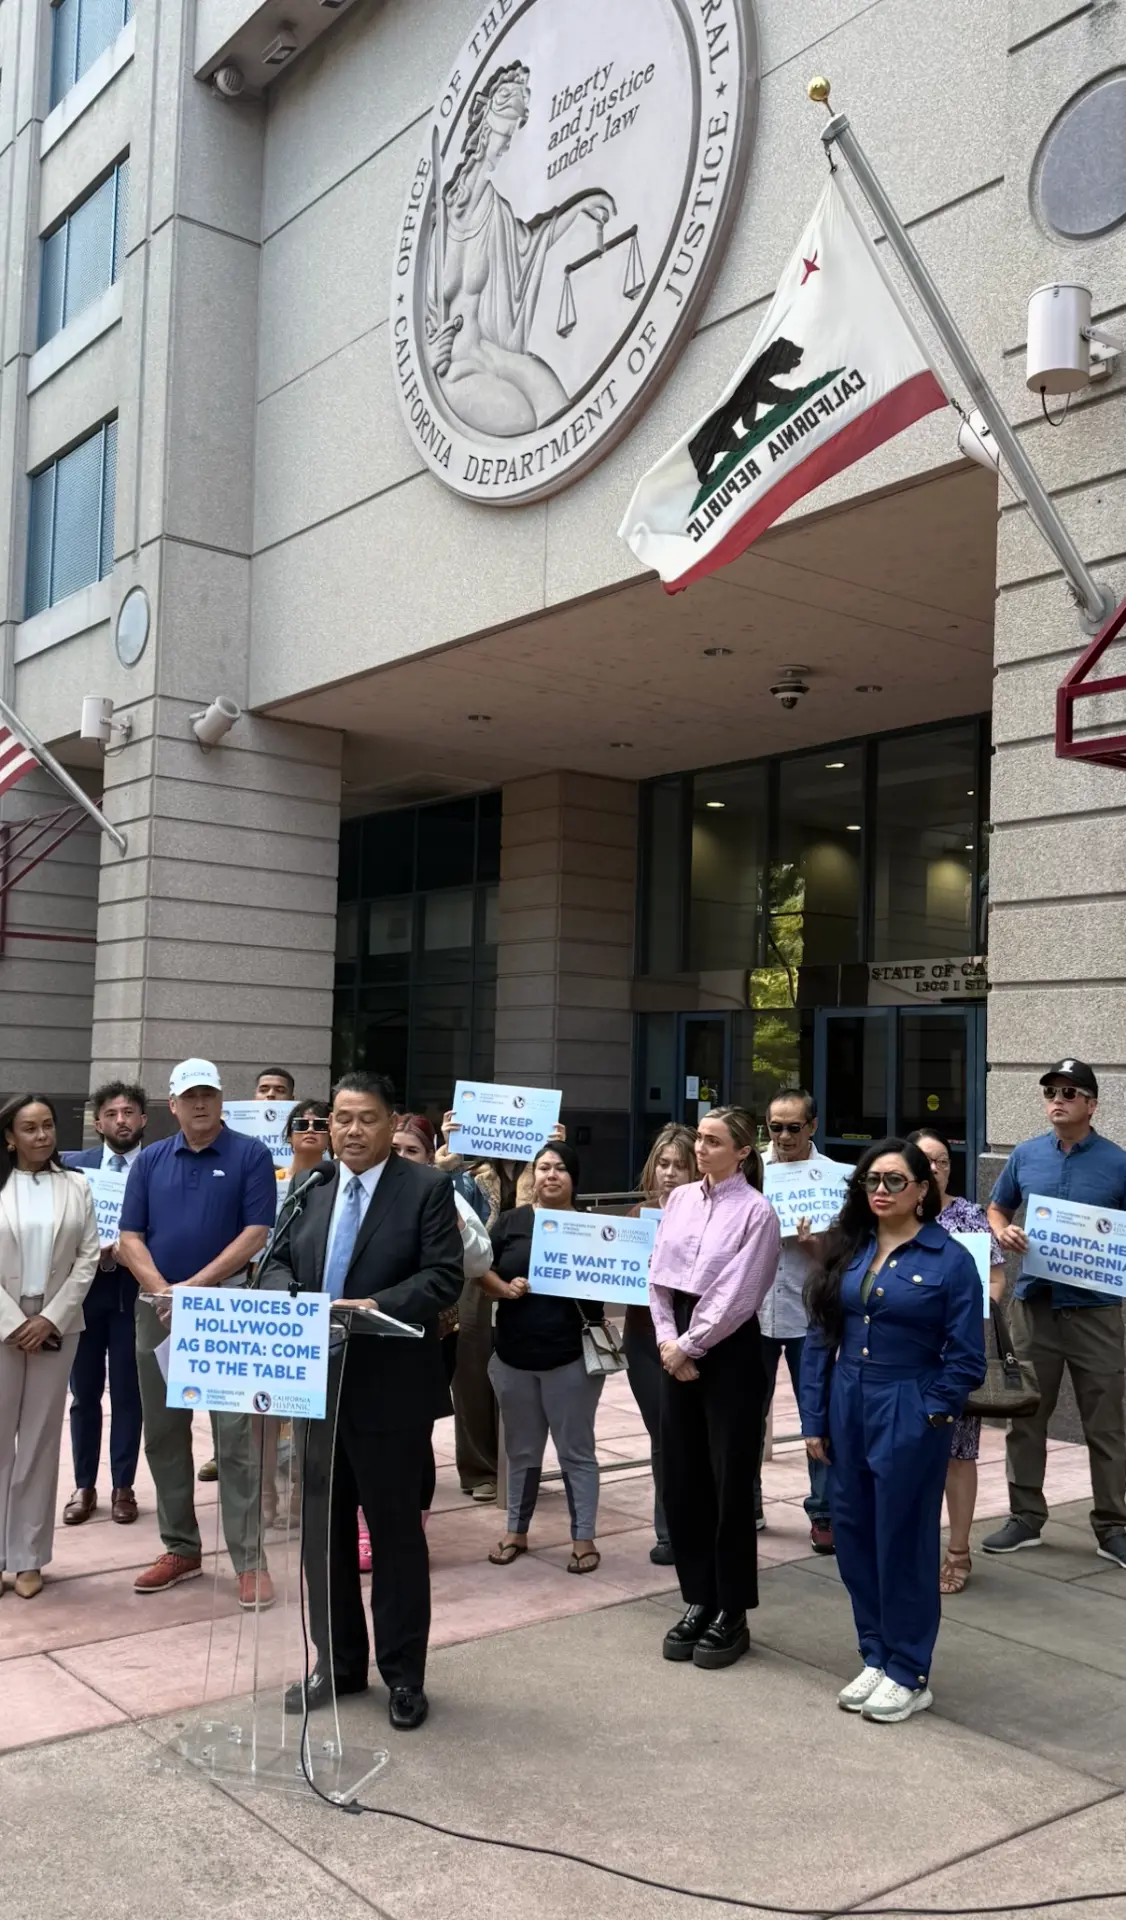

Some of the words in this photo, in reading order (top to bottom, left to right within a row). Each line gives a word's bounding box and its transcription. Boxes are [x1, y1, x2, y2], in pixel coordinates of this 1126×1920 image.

[548, 61, 614, 123] liberty
[548, 104, 583, 151] and
[585, 63, 655, 132] justice
[397, 157, 431, 277] OFFICE
[440, 70, 461, 118] OF
[468, 0, 513, 58] THE
[547, 136, 599, 180] under
[602, 104, 640, 143] law
[394, 315, 453, 468] CALIFORNIA
[463, 378, 619, 486] DEPARTMENT
[627, 320, 659, 376] OF
[663, 110, 729, 307] JUSTICE
[871, 965, 925, 981] STATE
[931, 964, 955, 979] OF
[477, 1113, 497, 1125] WE
[500, 1115, 533, 1128] KEEP
[462, 1124, 544, 1143] HOLLYWOOD
[471, 1138, 533, 1155] WORKING
[788, 1188, 816, 1201] ARE
[788, 1200, 840, 1213] VOICES
[1028, 1227, 1048, 1241] AG
[1050, 1231, 1105, 1253] BONTA:
[543, 1251, 568, 1265] WE
[572, 1254, 617, 1270] WANT
[620, 1259, 641, 1272] TO
[533, 1265, 572, 1280] KEEP
[575, 1270, 647, 1289] WORKING
[1047, 1260, 1123, 1287] WORKERS
[182, 1296, 225, 1312] REAL
[230, 1298, 291, 1316] VOICES
[295, 1302, 320, 1317] OF
[195, 1317, 304, 1337] HOLLYWOOD
[176, 1337, 200, 1352] AG
[204, 1339, 267, 1357] BONTA:
[271, 1343, 321, 1360] COME
[188, 1359, 211, 1374] TO
[215, 1361, 248, 1377] THE
[253, 1363, 306, 1381] TABLE
